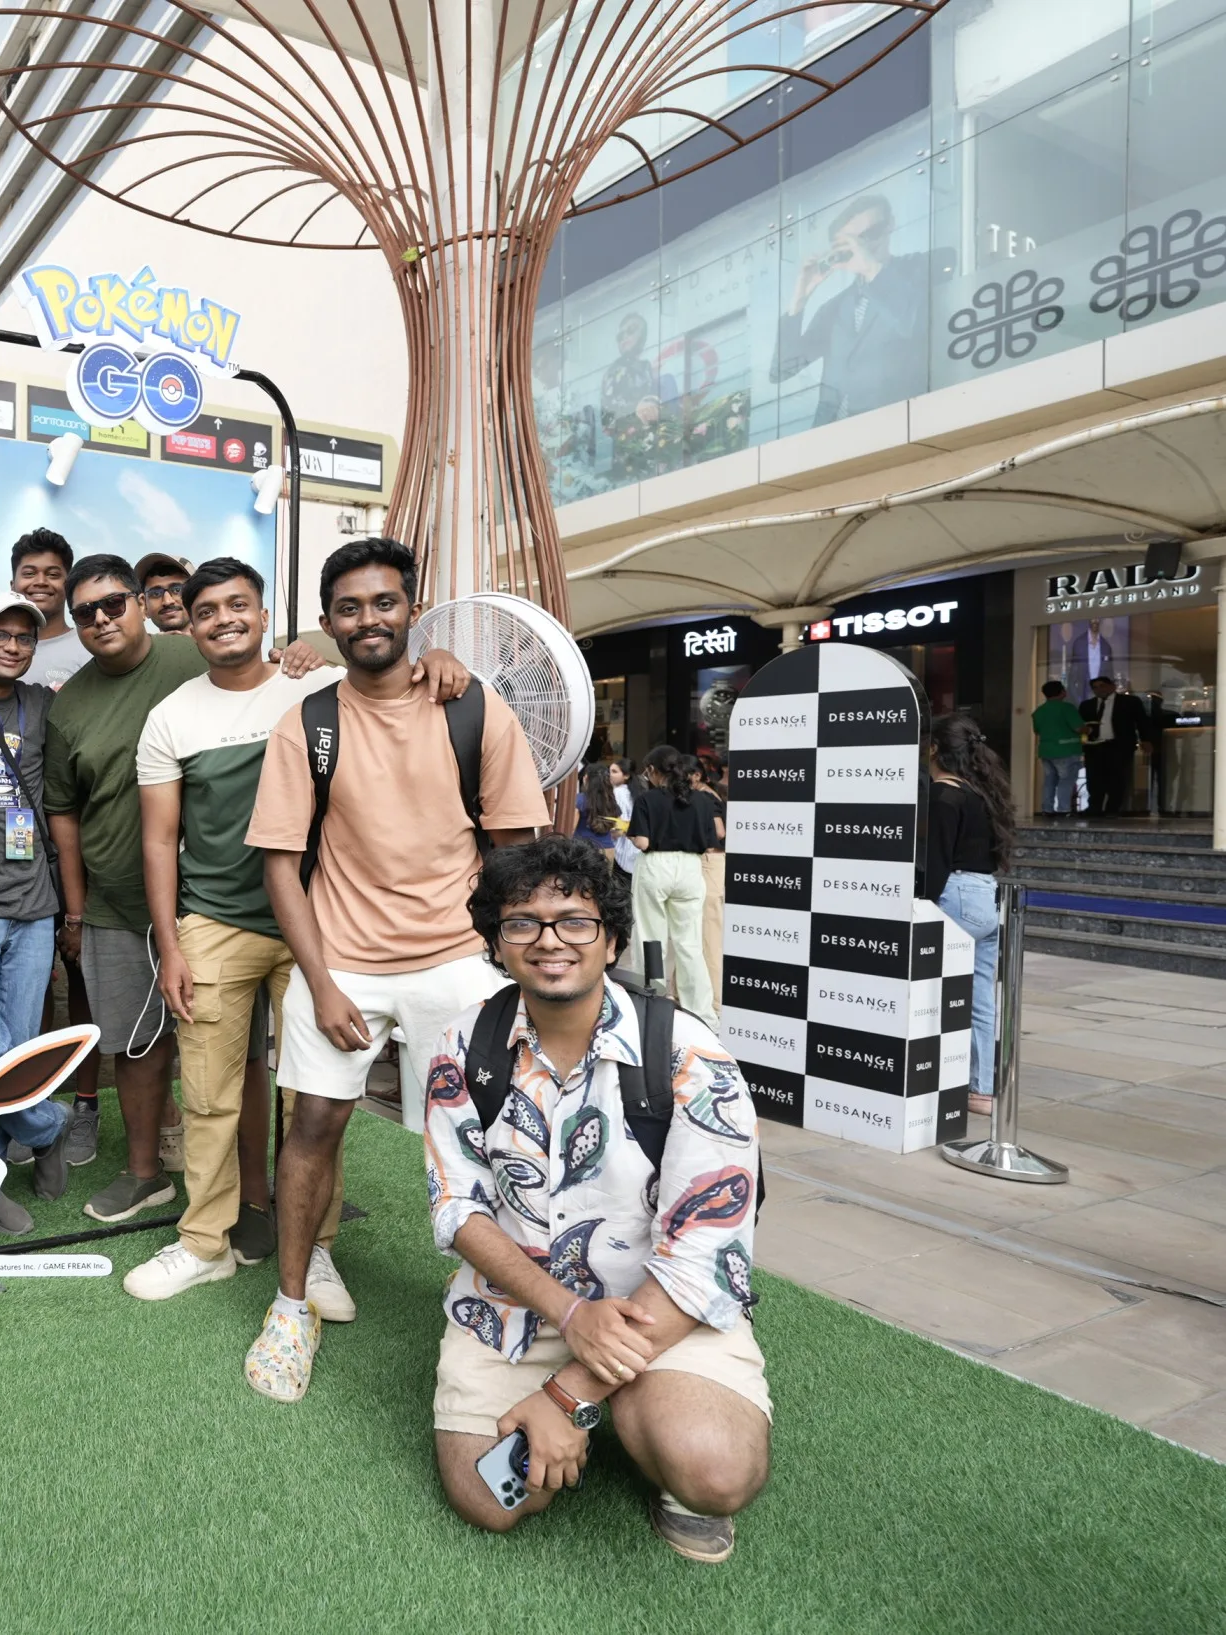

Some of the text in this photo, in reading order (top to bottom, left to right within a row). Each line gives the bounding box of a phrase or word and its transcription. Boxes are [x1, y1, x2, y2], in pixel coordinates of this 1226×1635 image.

[77, 342, 203, 420] GO
[1046, 585, 1201, 613] SWITZERLAND
[832, 601, 958, 637] TISSOT
[739, 714, 807, 727] DESSANGE
[829, 709, 907, 722] DESSANGE
[315, 727, 333, 774] safari
[737, 769, 806, 778] DESSANGE
[827, 768, 905, 777] DESSANGE
[736, 821, 803, 832] DESSANGE
[825, 823, 903, 835] DESSANGE
[734, 873, 801, 886] DESSANGE
[823, 879, 901, 893] DESSANGE
[732, 924, 799, 939] DESSANGE
[821, 934, 899, 951] DESSANGE
[920, 947, 935, 955] SALON
[730, 975, 798, 994] DESSANGE
[819, 989, 896, 1010] DESSANGE
[949, 999, 965, 1008] SALON
[729, 1026, 795, 1048] DESSANGE
[817, 1044, 894, 1068] DESSANGE
[868, 1063, 894, 1072] PARIS
[916, 1061, 932, 1071] SALON
[746, 1082, 793, 1101] SANGE
[771, 1096, 793, 1105] PARIS
[815, 1099, 892, 1126] DESSANGE
[945, 1110, 960, 1120] SALON
[43, 1262, 65, 1270] GAME
[68, 1262, 92, 1270] FREAK
[93, 1262, 106, 1270] Inc.
